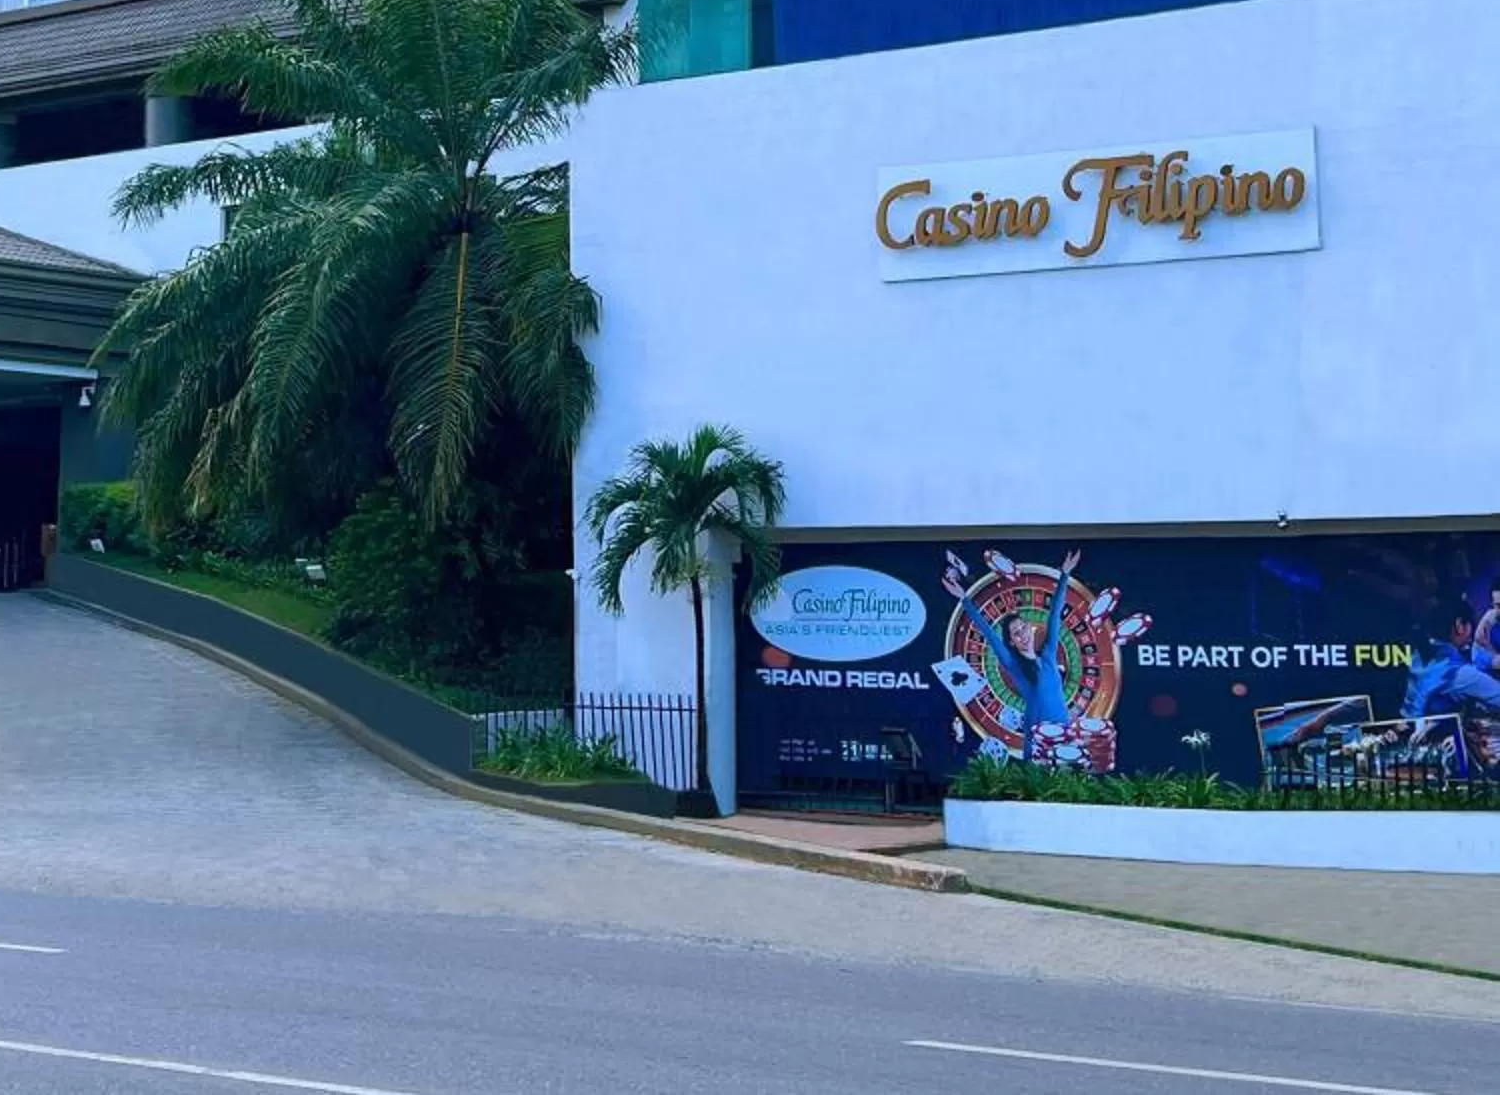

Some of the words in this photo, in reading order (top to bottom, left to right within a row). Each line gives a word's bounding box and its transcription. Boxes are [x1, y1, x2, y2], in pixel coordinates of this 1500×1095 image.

[876, 180, 1051, 250] Casino
[1062, 151, 1305, 258] Filipino
[791, 588, 845, 615] Casino
[843, 588, 911, 622] Filipino
[1137, 645, 1171, 666] BE
[1177, 646, 1244, 668] PART
[1250, 646, 1288, 668] OF
[1293, 644, 1348, 666] THE
[1355, 645, 1412, 666] FUN
[846, 669, 930, 690] REGAL
